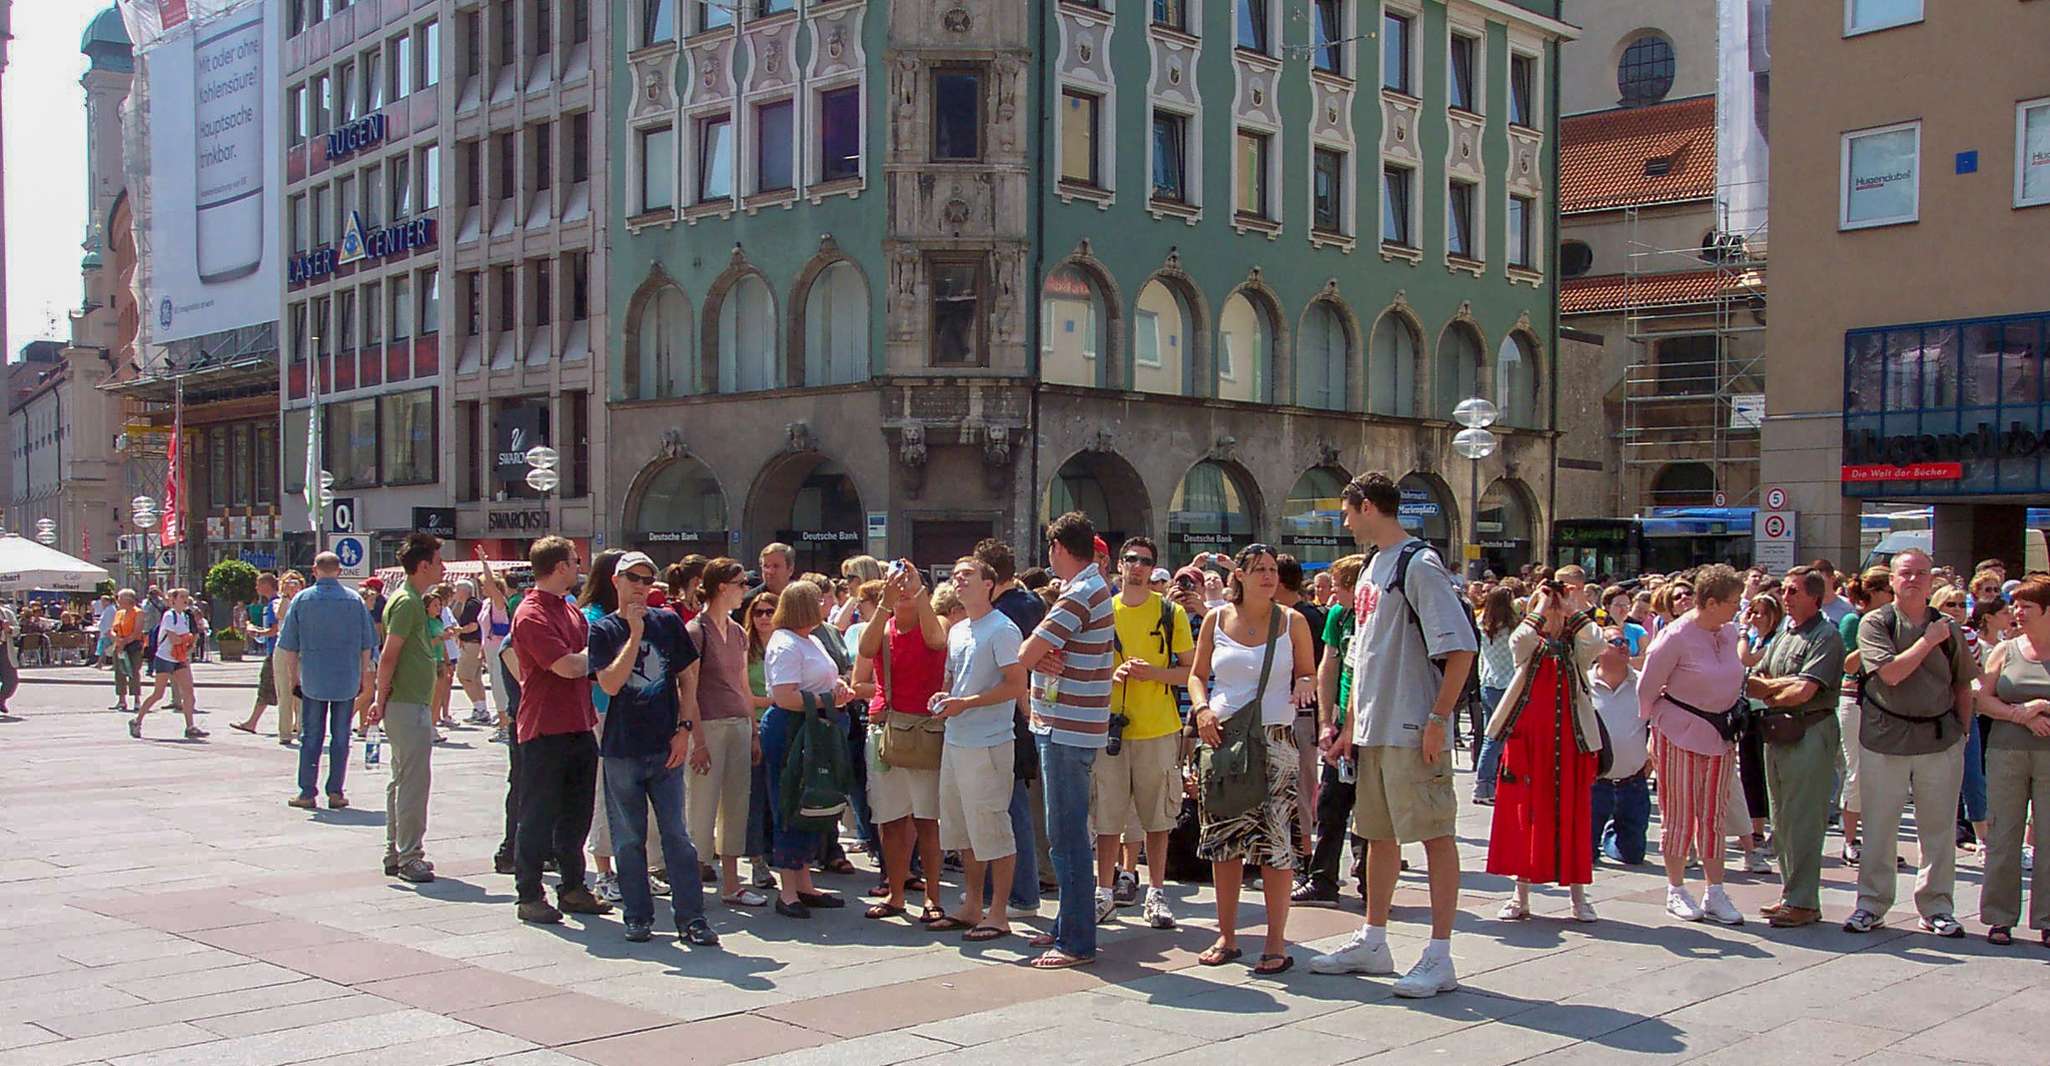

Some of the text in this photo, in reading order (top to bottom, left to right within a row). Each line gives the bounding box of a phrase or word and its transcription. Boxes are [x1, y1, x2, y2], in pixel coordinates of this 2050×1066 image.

[212, 47, 235, 70] oder
[237, 38, 258, 60] ohne
[200, 104, 253, 139] Hauptsache
[326, 114, 384, 159] AUGEN
[288, 218, 432, 283] LASER CENTER
[499, 452, 526, 465] SWARO
[1852, 469, 1867, 478] Die
[1871, 468, 1892, 477] Welt
[1894, 468, 1911, 477] der
[1773, 493, 1780, 505] 5
[489, 511, 550, 530] SWAROVSI
[649, 532, 699, 541] Deutsche Bank
[802, 531, 858, 541] Deutsche Bank
[1183, 534, 1233, 543] Deutsche Bank
[1293, 536, 1337, 545] Deutsche Bank
